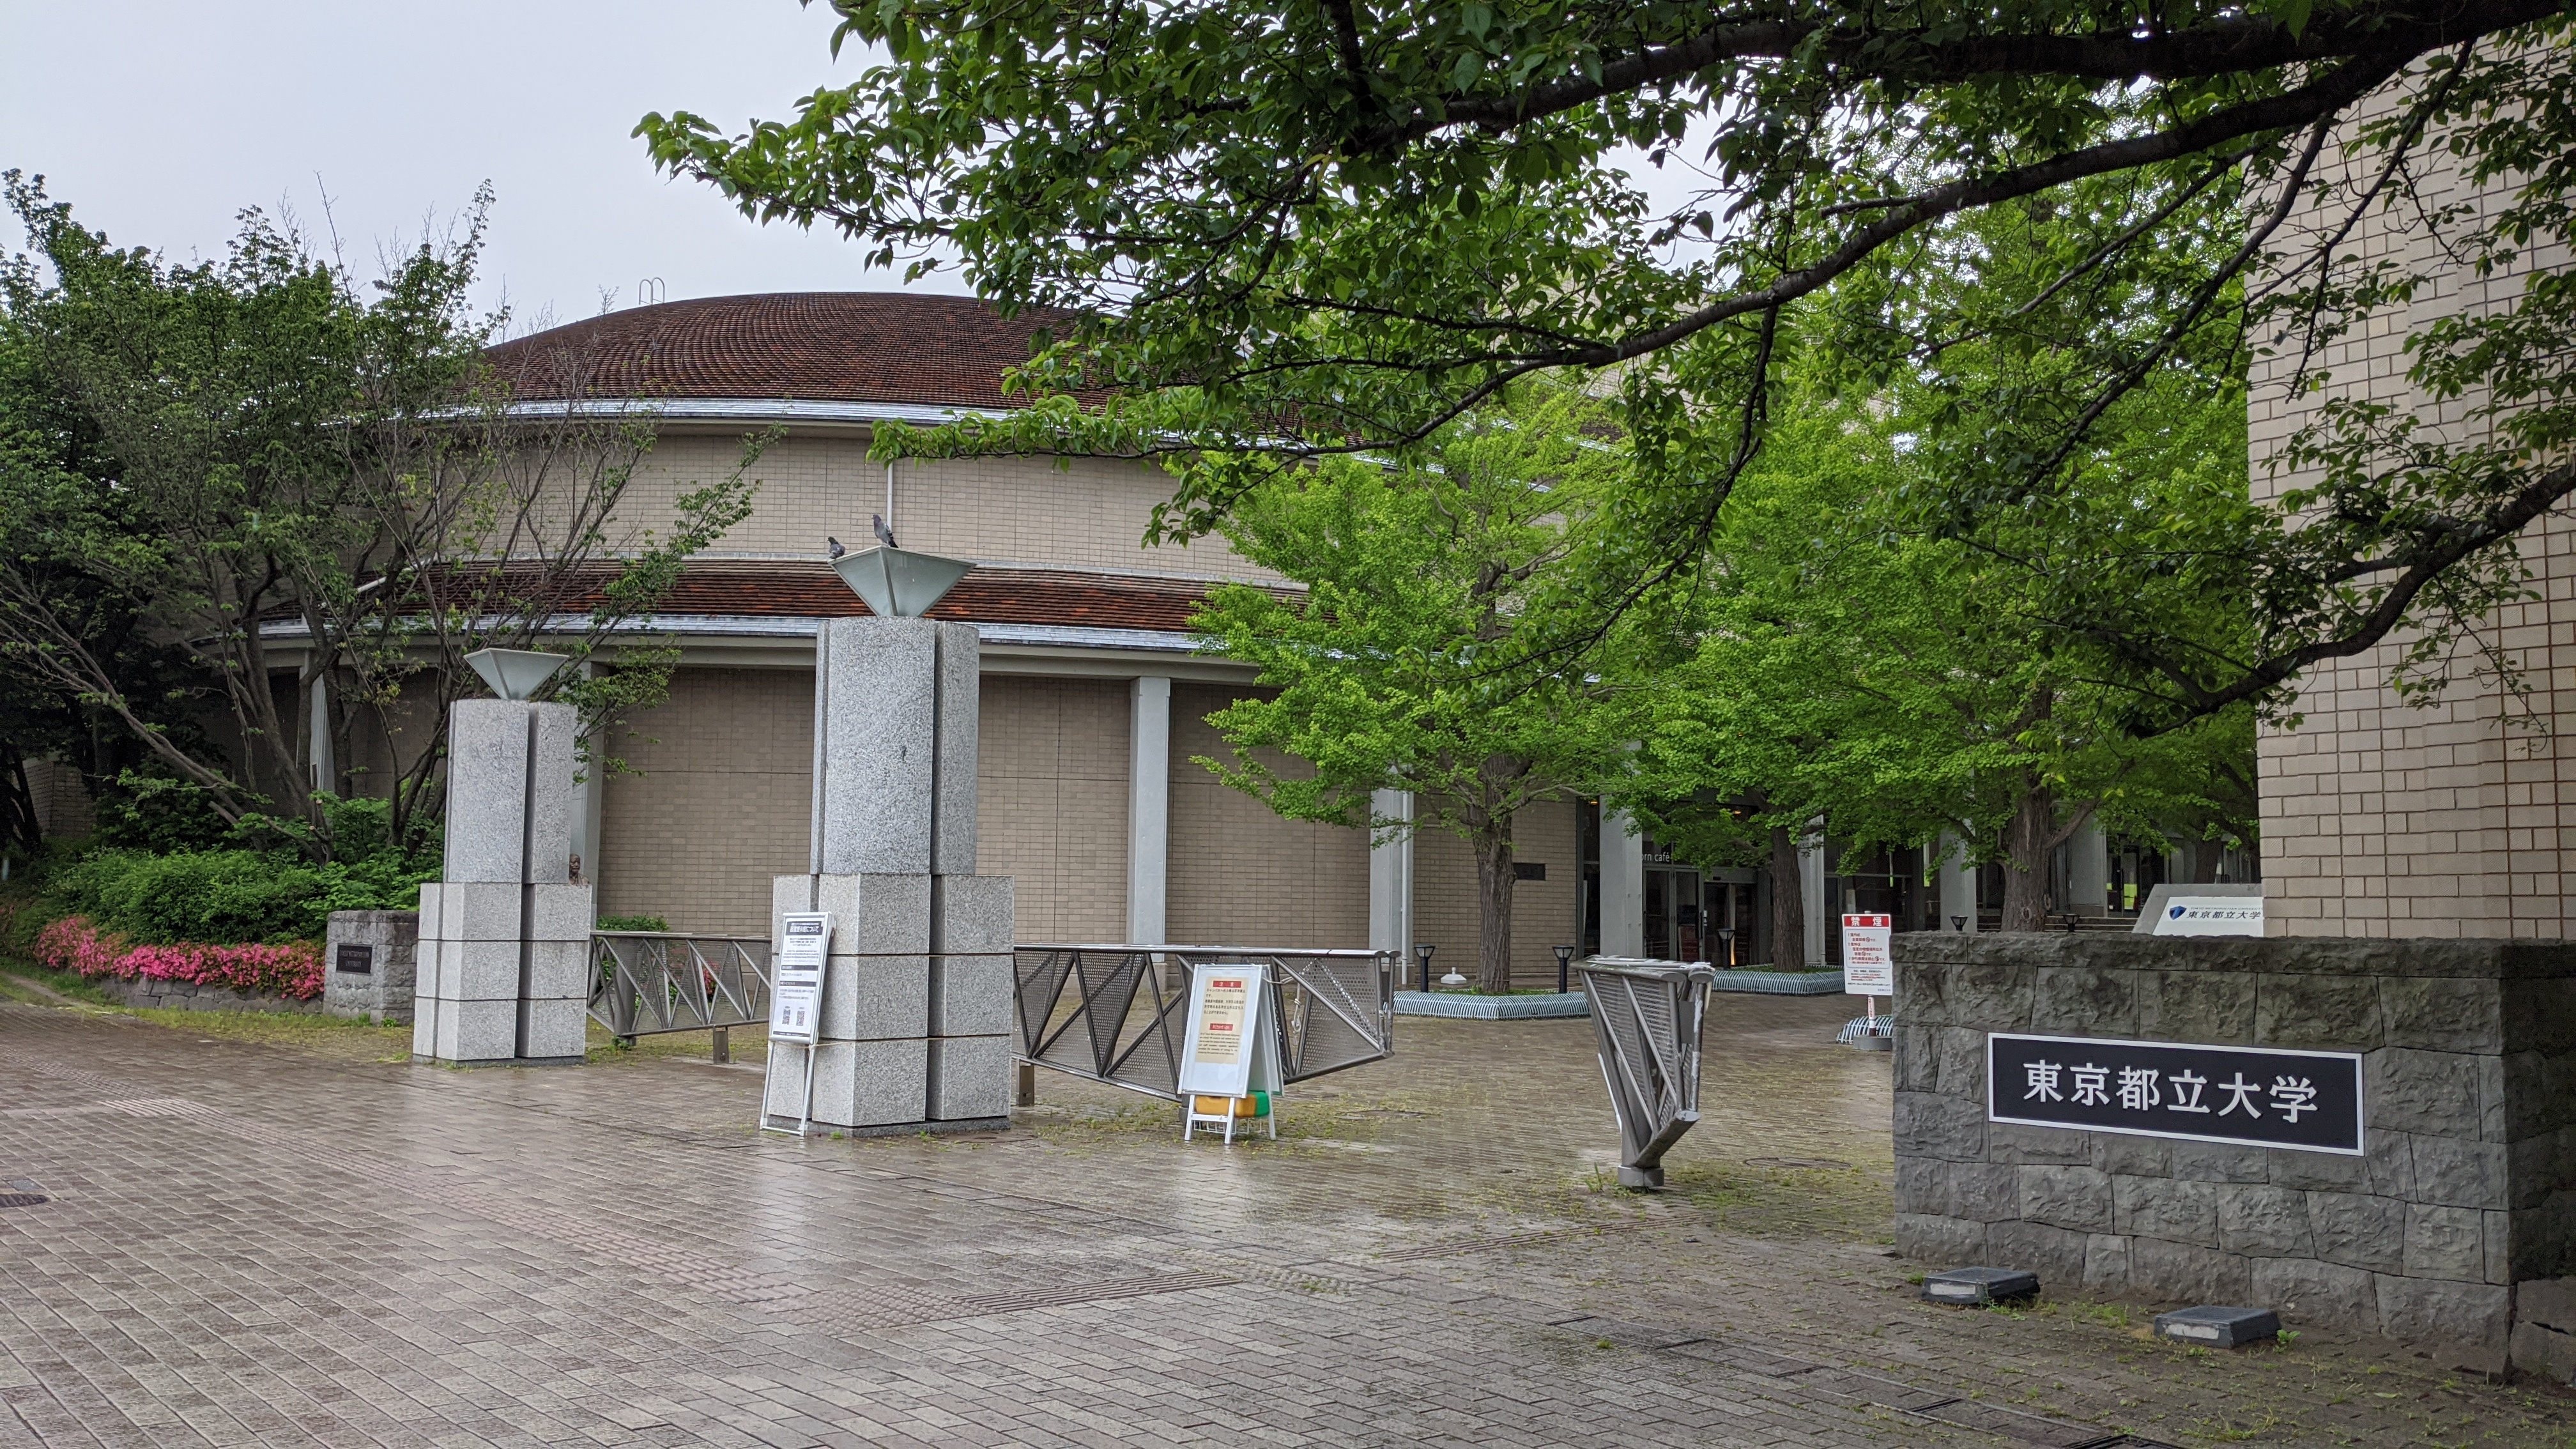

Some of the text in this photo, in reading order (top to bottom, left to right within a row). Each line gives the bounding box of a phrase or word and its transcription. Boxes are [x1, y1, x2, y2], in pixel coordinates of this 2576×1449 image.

[1655, 852, 1670, 862] café
[2186, 911, 2261, 919] 東京都立大学
[1851, 916, 1882, 926] 禁煙
[2021, 1058, 2319, 1124] 東京都立大学
